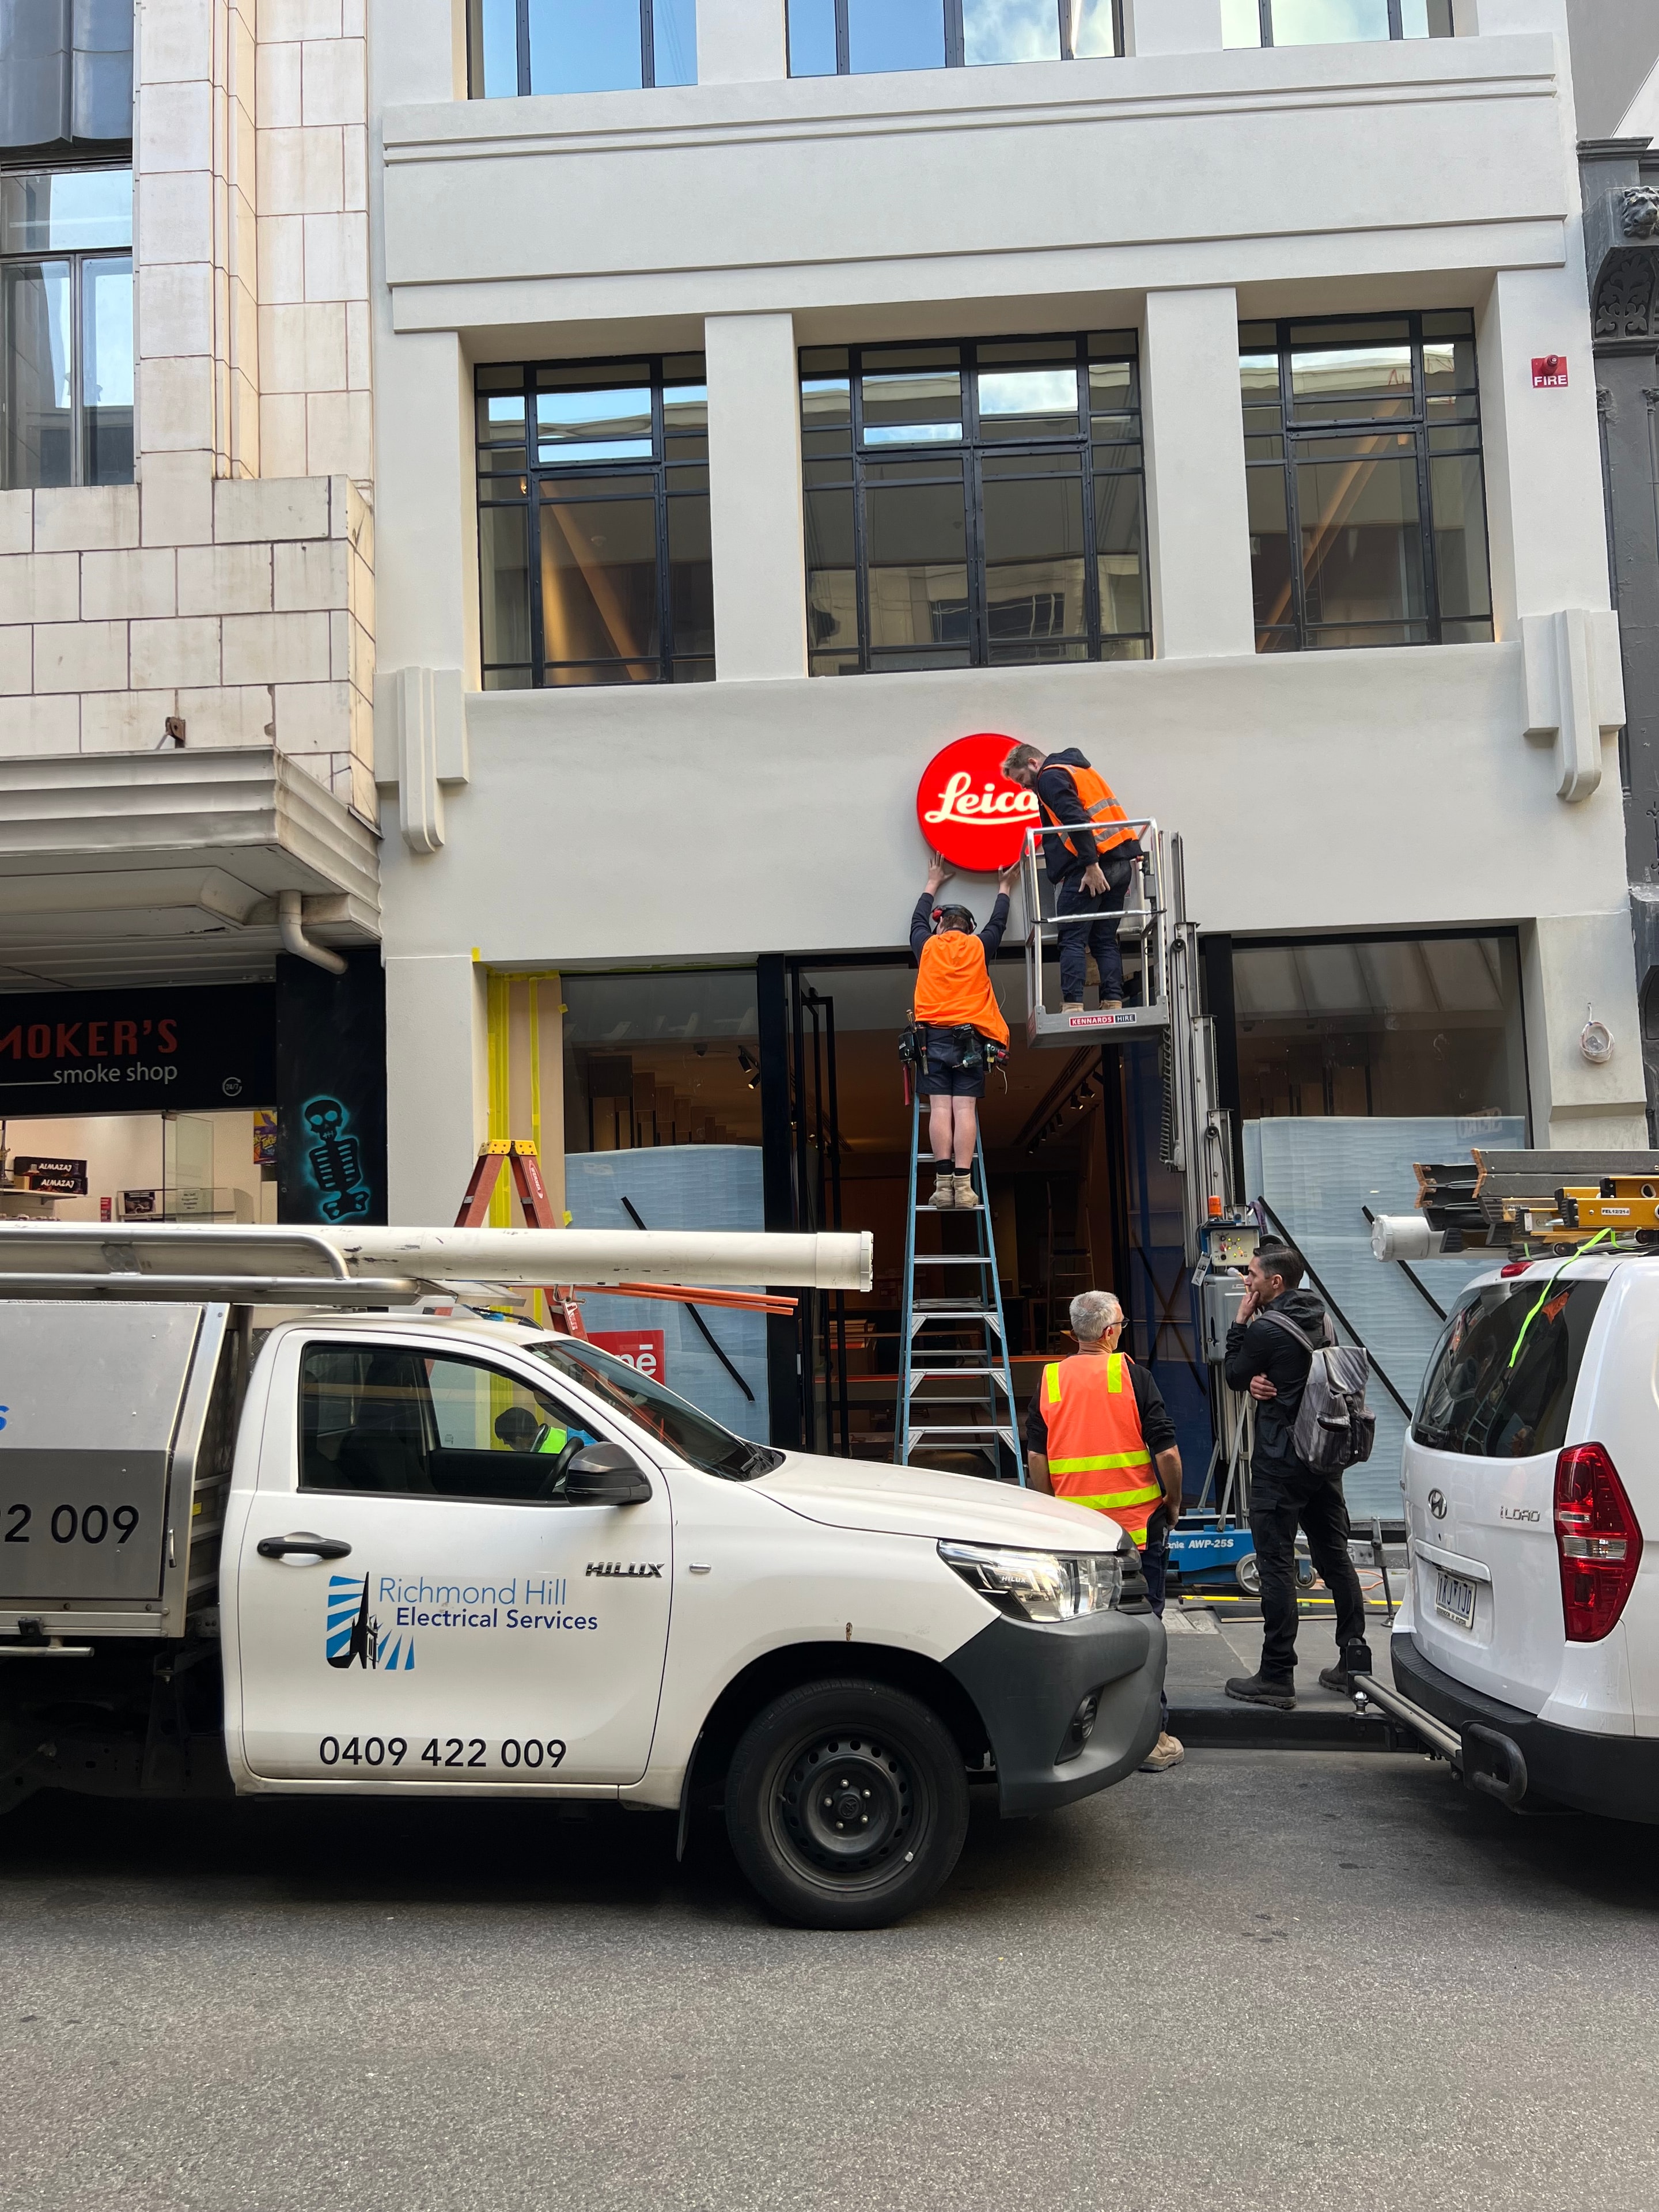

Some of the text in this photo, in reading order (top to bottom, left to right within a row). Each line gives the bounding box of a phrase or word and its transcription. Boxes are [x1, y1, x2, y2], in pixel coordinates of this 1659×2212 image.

[1534, 375, 1567, 386] FIRE
[925, 772, 1040, 825] Leica
[1072, 1017, 1112, 1025] KENNARDS
[54, 1062, 177, 1084] smoke shop
[41, 1179, 75, 1188] ALMAZAJ
[51, 1504, 139, 1544] 009
[1188, 1539, 1234, 1549] AWP-25S
[586, 1562, 665, 1578] HILUX
[380, 1577, 566, 1605] Richmond Hill
[396, 1606, 598, 1630] Electrical Services
[320, 1736, 567, 1768] 0409 422 009
